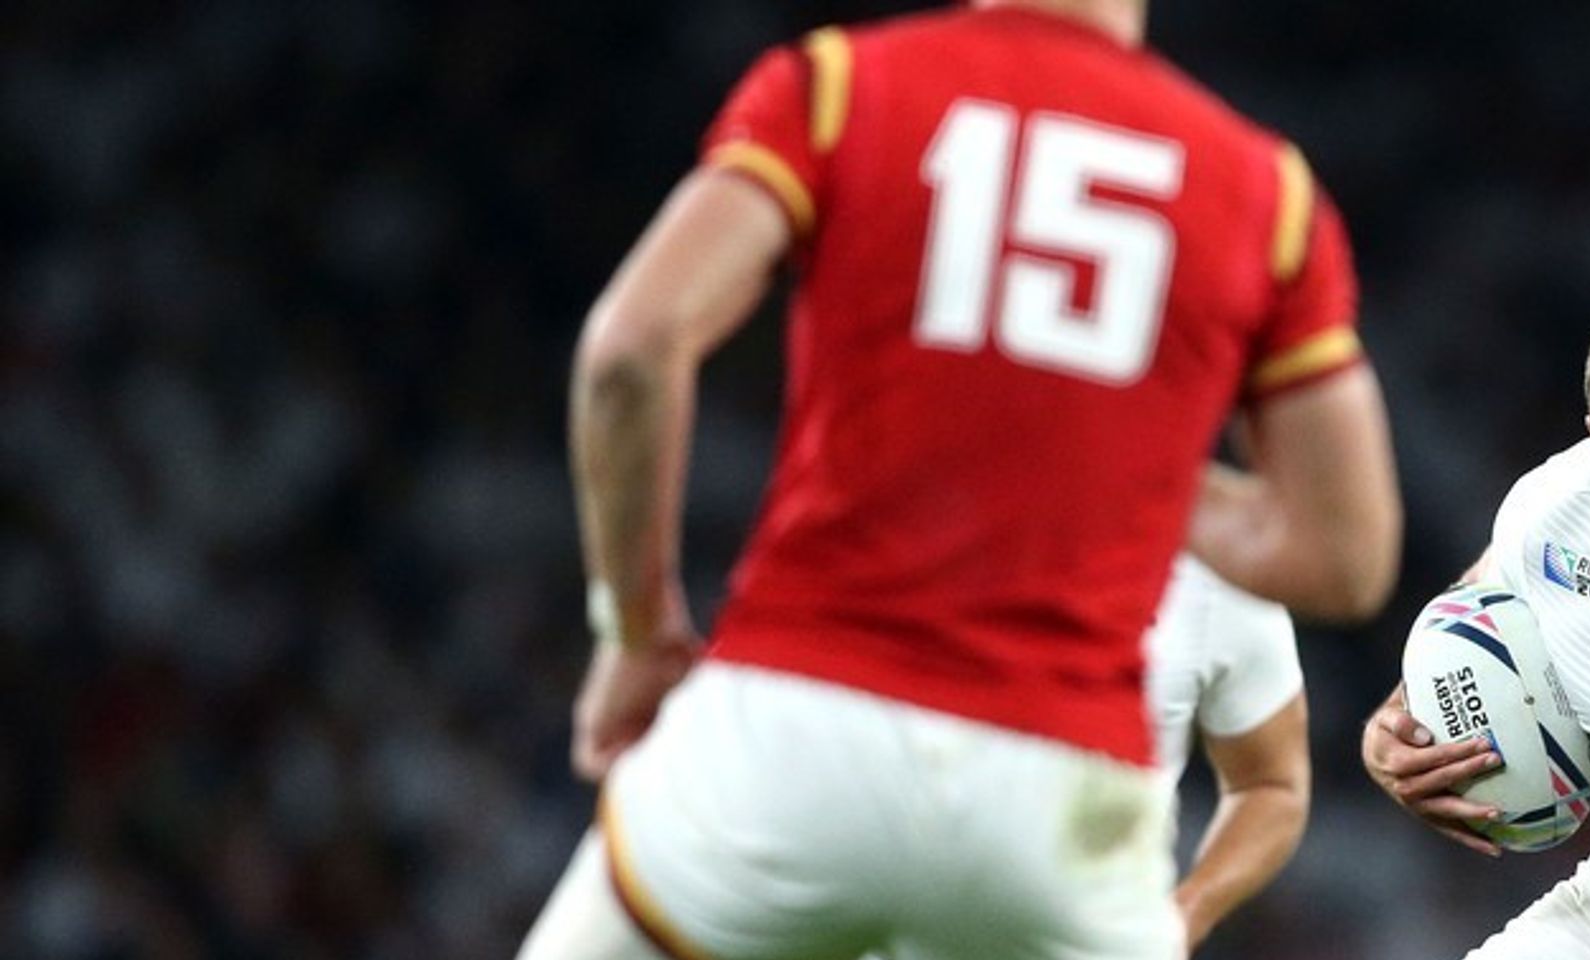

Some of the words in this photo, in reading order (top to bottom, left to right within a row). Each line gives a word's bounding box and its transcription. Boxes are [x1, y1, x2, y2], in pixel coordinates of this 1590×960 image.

[912, 96, 1187, 388] 15
[1432, 675, 1463, 738] RUGBY
[1456, 666, 1489, 728] 2015
